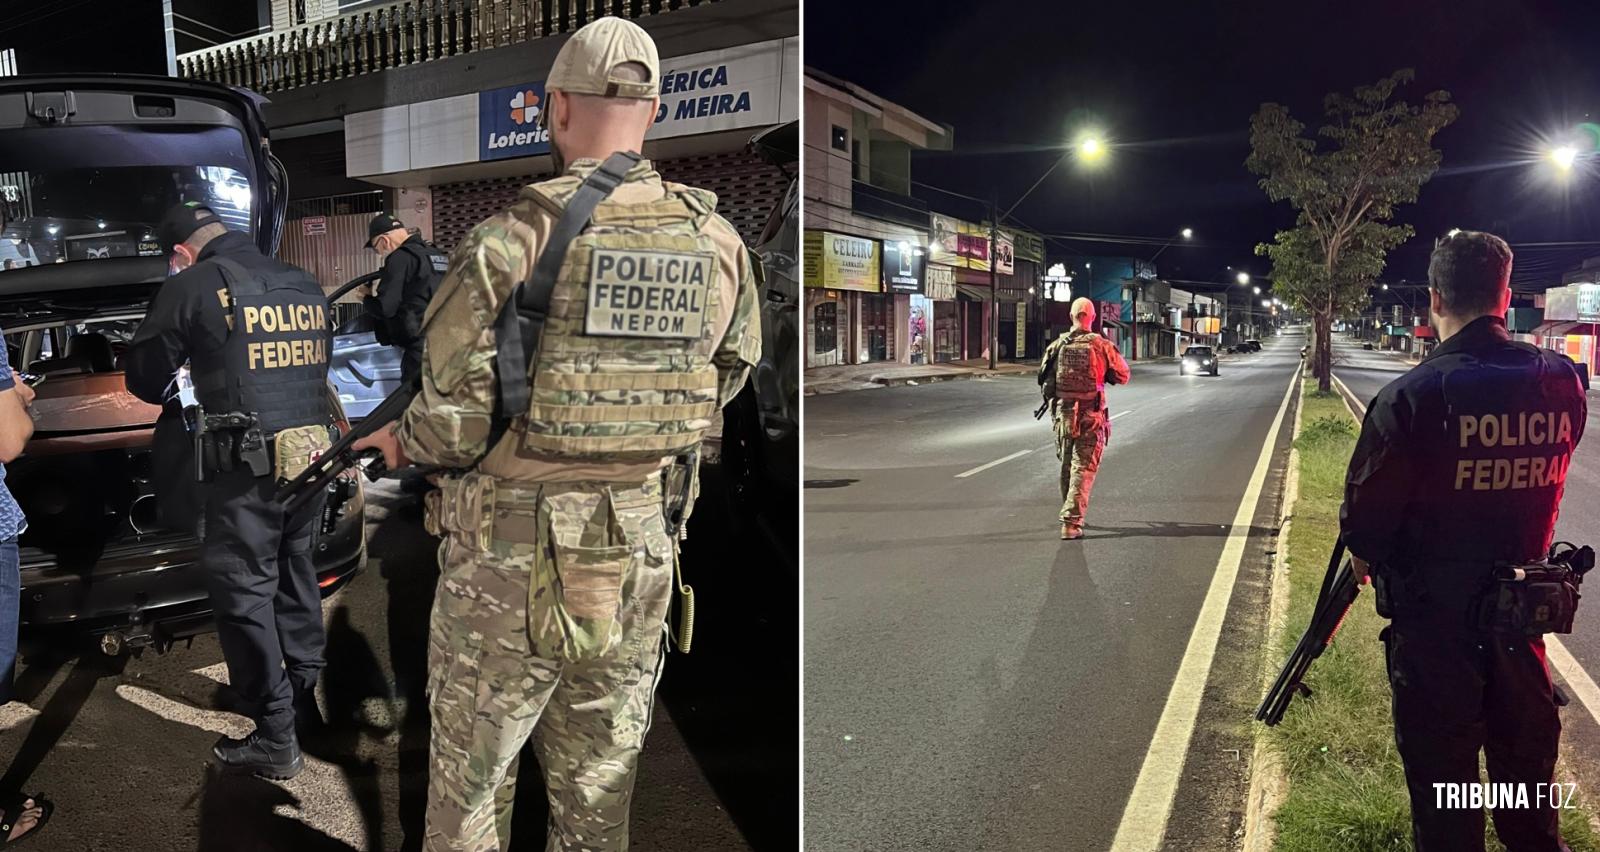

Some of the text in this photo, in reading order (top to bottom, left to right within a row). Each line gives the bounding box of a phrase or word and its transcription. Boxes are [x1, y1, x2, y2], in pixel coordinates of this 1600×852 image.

[659, 65, 728, 95] ÉRICA
[674, 91, 751, 121] MEIRA
[833, 238, 874, 260] CELEIRO
[594, 283, 700, 313] FEDERAL
[611, 313, 685, 333] NEPOM
[248, 339, 327, 369] FEDERAL
[1455, 453, 1570, 490] FEDERAL
